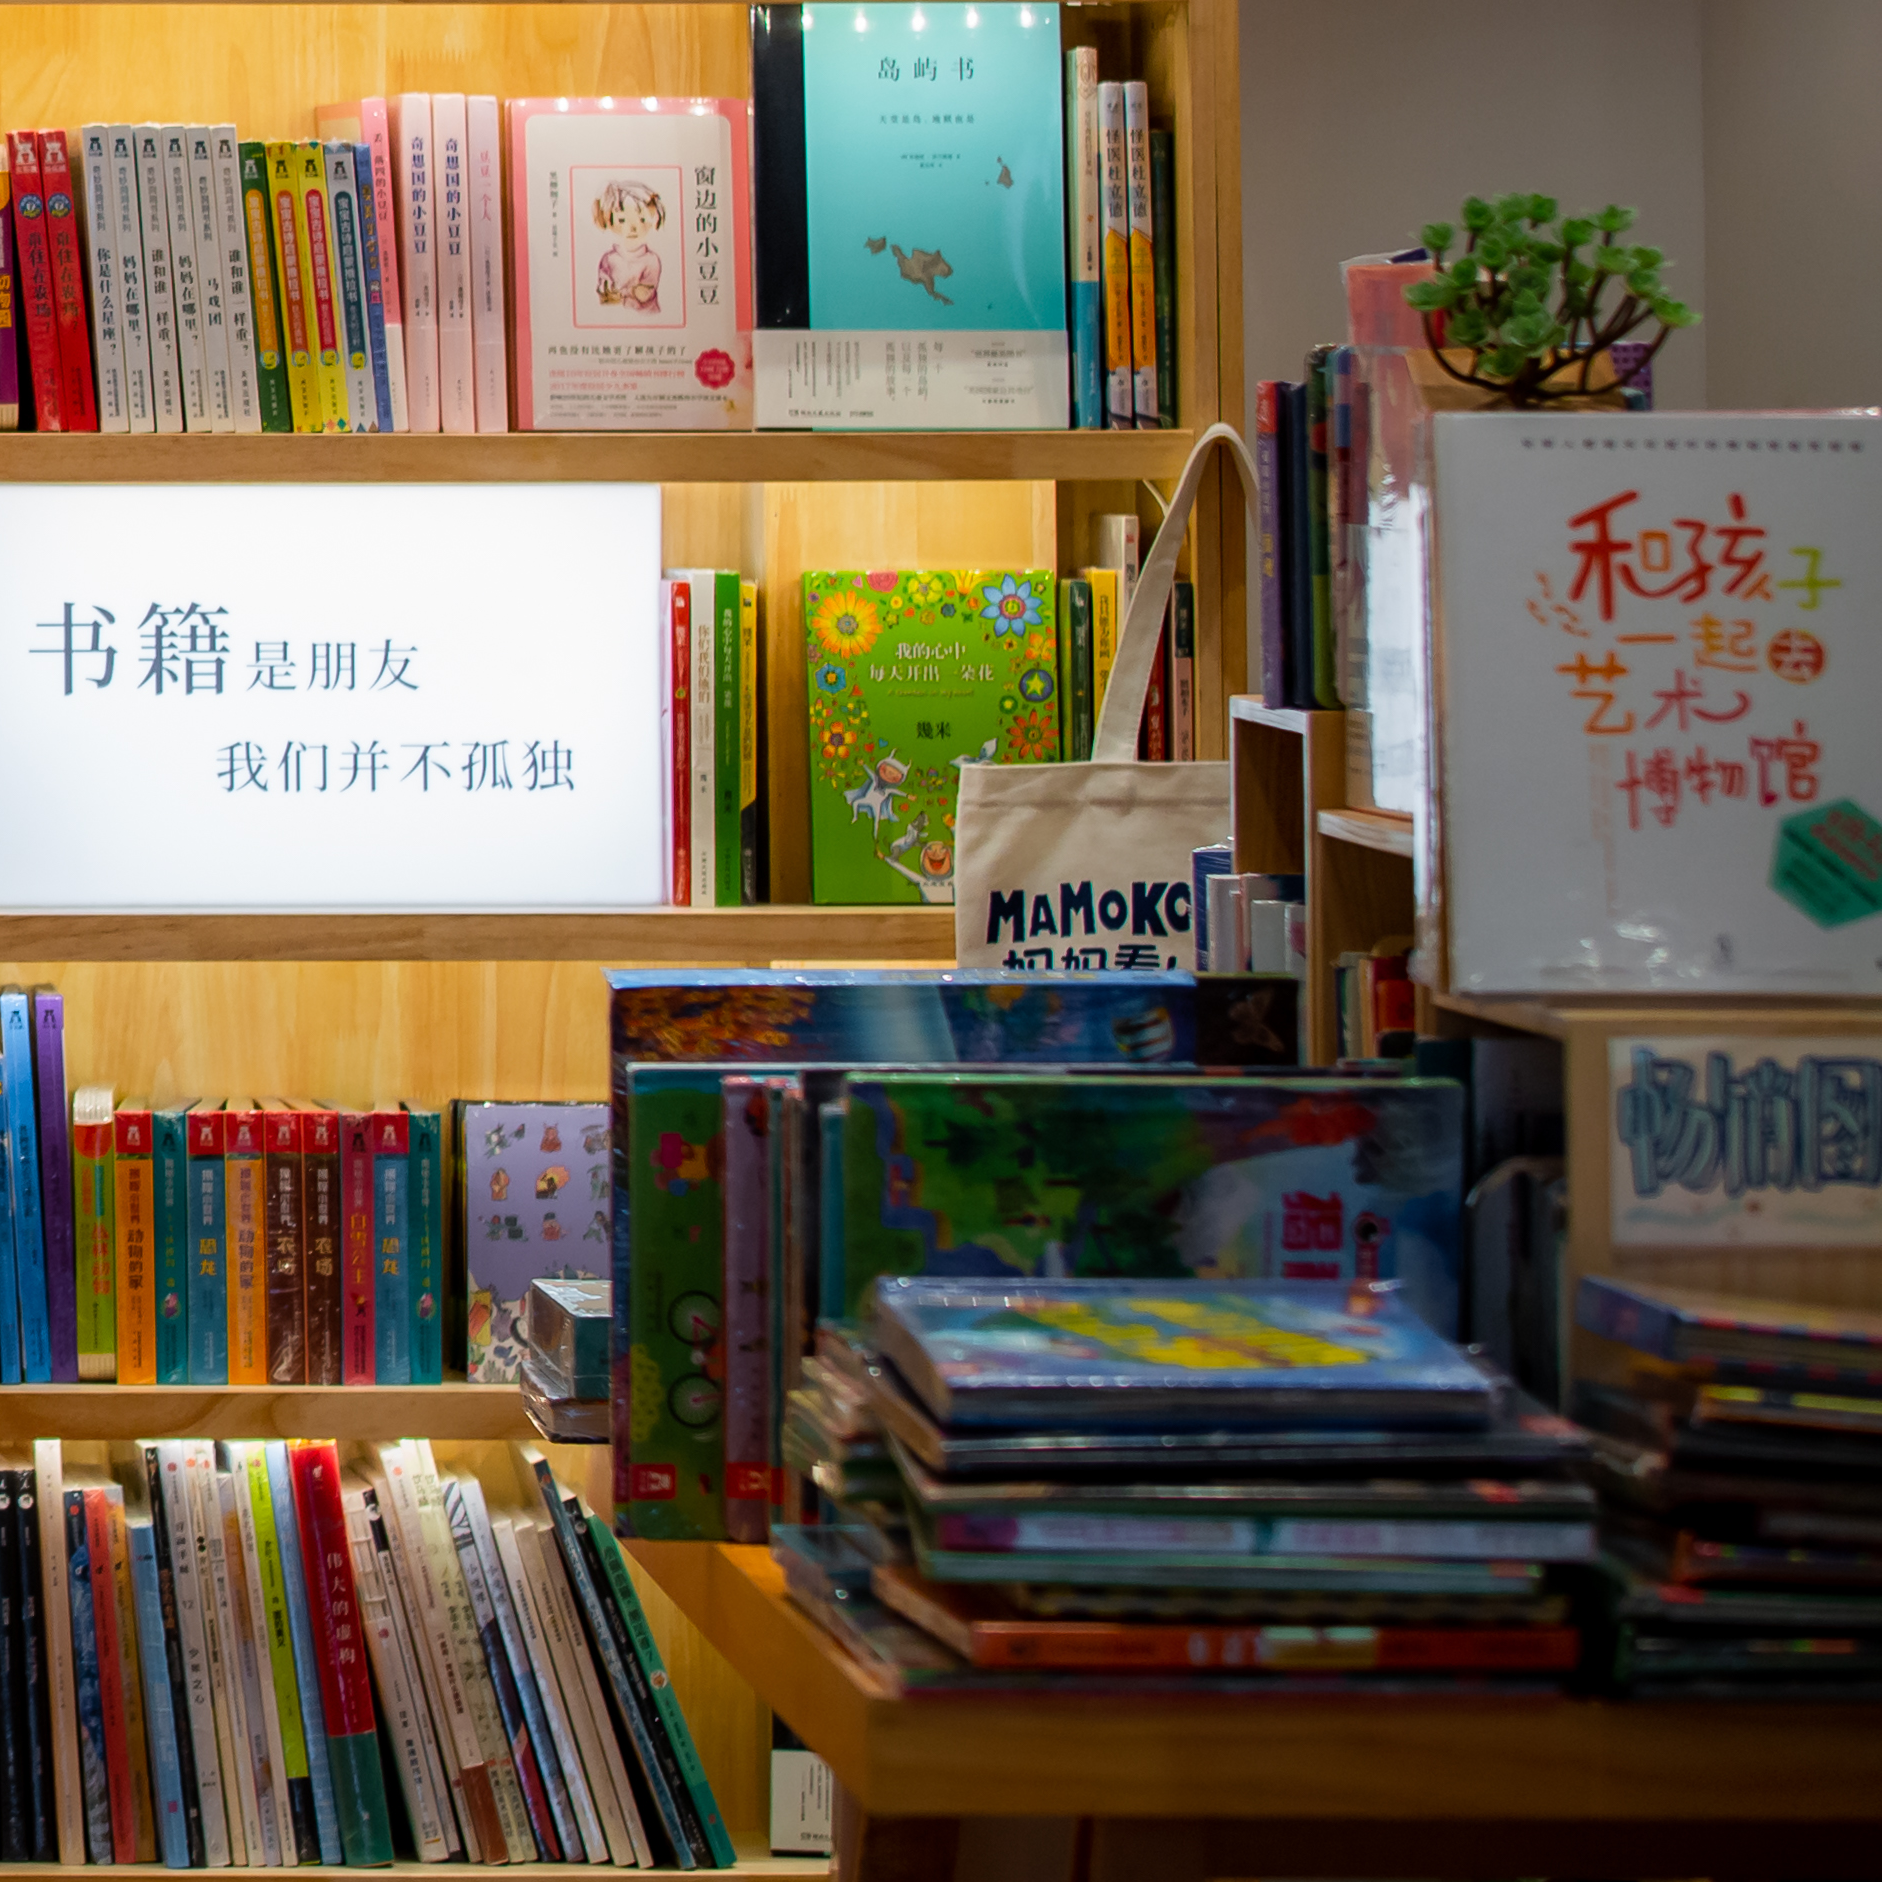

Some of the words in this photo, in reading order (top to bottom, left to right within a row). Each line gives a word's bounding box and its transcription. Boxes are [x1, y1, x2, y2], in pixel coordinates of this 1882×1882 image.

[877, 55, 976, 83] 岛屿书
[1104, 127, 1125, 219] 怪医杜立德
[1129, 127, 1149, 218] 怪医杜立德
[693, 164, 720, 306] 窗边的小豆豆
[96, 247, 118, 357] 你是什么星座？
[122, 254, 144, 348] 妈妈在哪里？
[151, 247, 173, 357] 谁和谁一样重？
[178, 254, 200, 347] 妈妈在哪里？
[206, 277, 223, 328] 马戏团
[228, 247, 251, 358] 谁和谁一样重？
[1567, 489, 1841, 621] 和孩子
[29, 601, 421, 698] 书籍是朋友
[869, 664, 996, 684] 每天开出一朵花
[894, 641, 968, 662] 我的心中
[1619, 614, 1825, 684] 一起去
[916, 720, 952, 741] 幾米
[1556, 651, 1752, 736] 艺术
[216, 738, 576, 794] 我们并不孤独
[1617, 718, 1822, 829] 博物馆
[126, 1228, 145, 1290] 动物的家
[198, 1237, 218, 1277] 恐龙
[314, 1236, 334, 1277] 农场
[380, 1237, 400, 1277] 恐龙
[326, 1551, 356, 1666] 伟大的虚构
